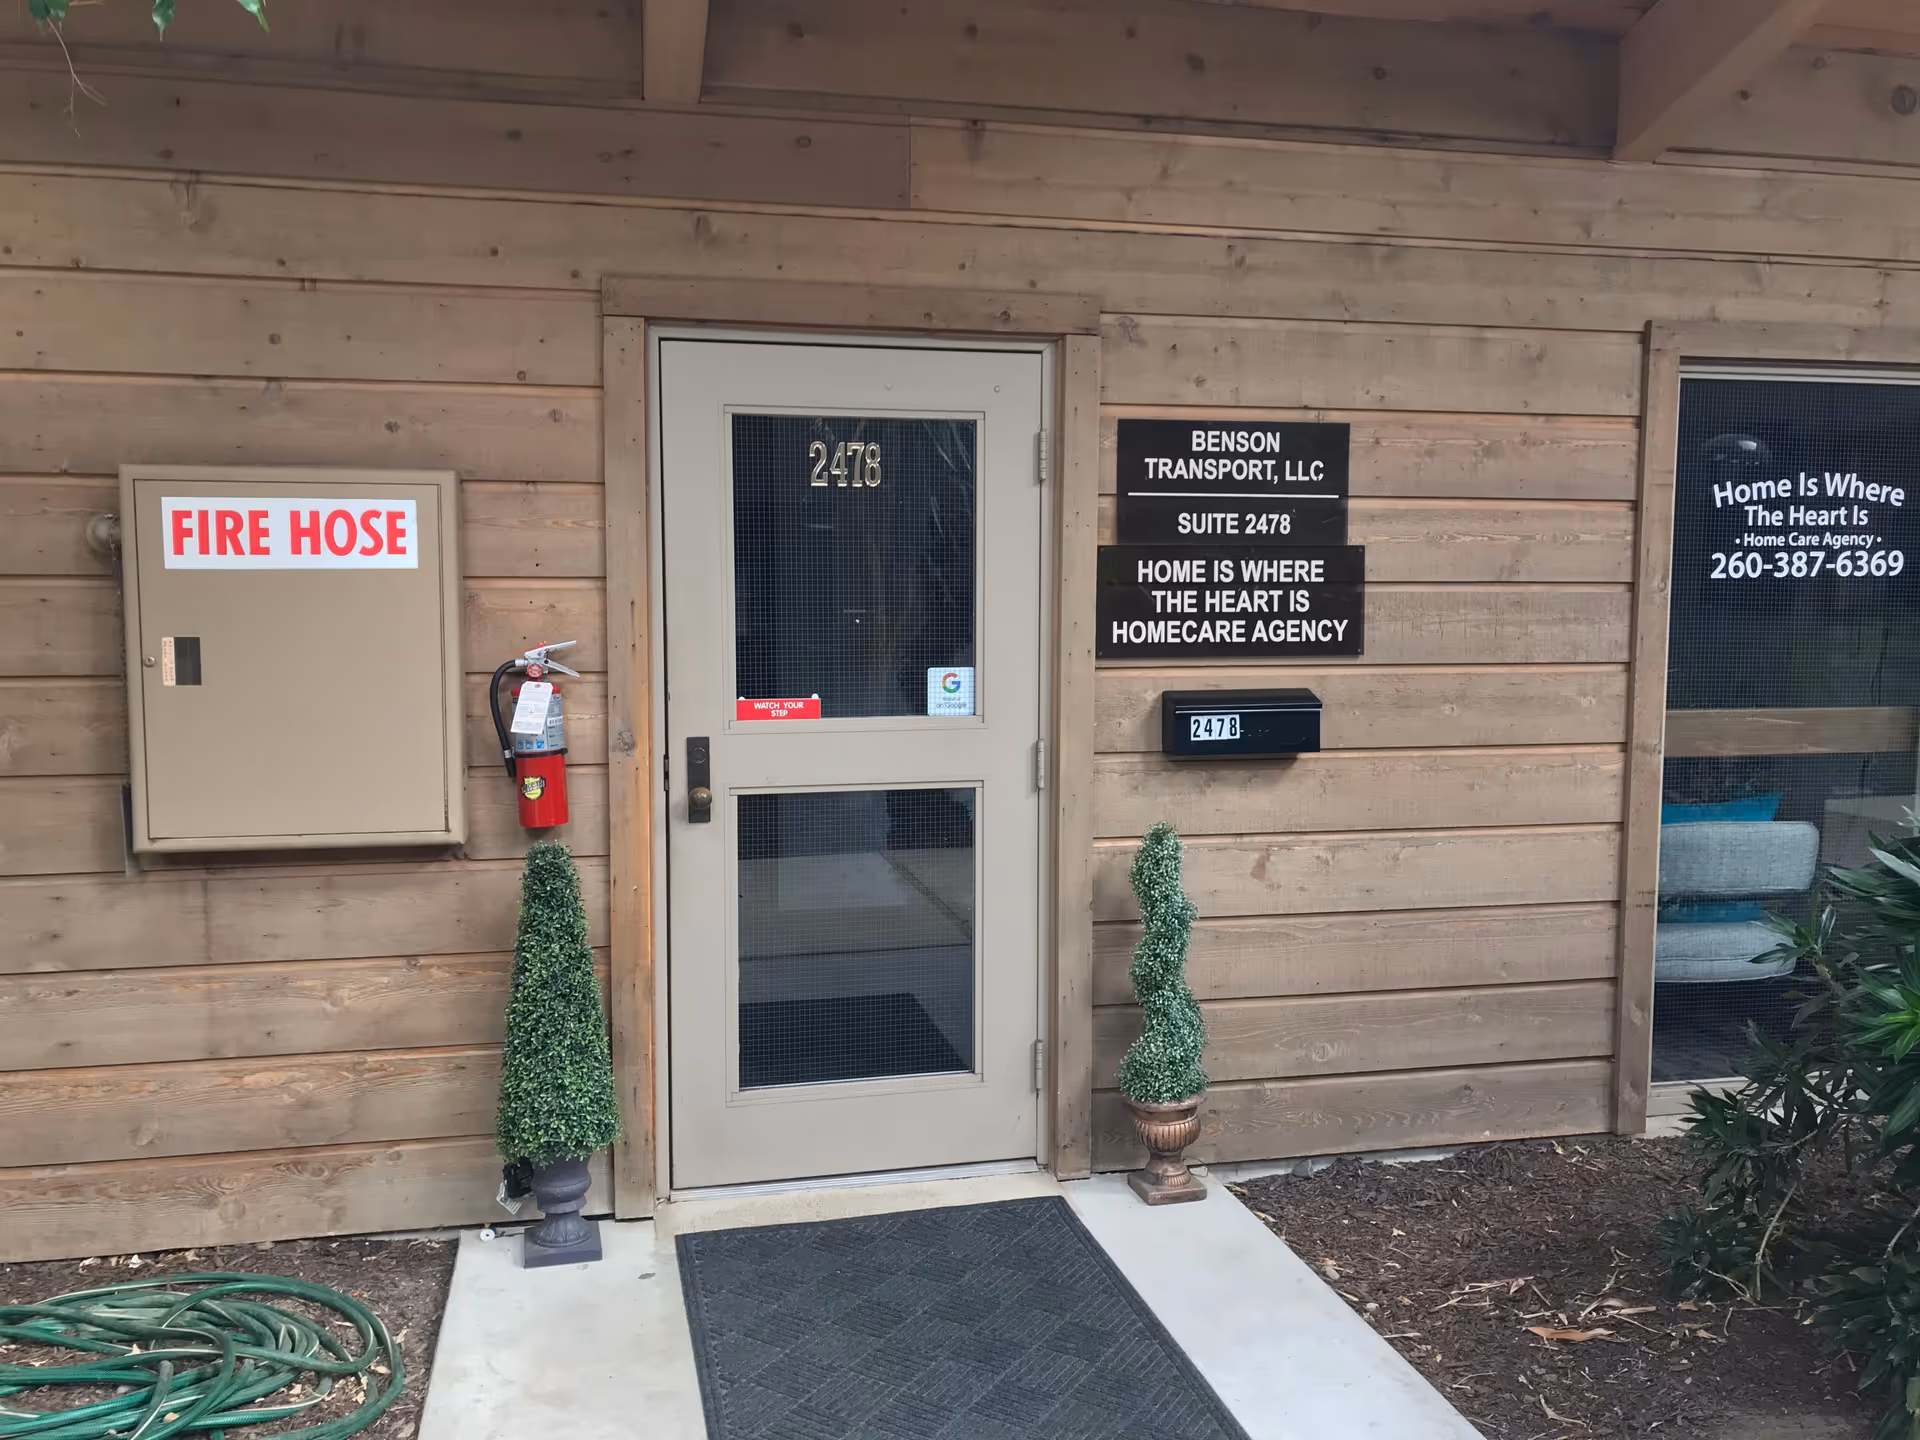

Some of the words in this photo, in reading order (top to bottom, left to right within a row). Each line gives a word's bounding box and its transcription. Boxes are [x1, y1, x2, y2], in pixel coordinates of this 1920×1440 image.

[1191, 430, 1280, 453] BENSON
[809, 441, 882, 487] 2478
[1144, 457, 1279, 485] TRANSPORT,
[1285, 460, 1325, 481] LLC
[1713, 477, 1792, 508] Home
[1799, 471, 1818, 497] Is
[1824, 472, 1905, 507] Where
[1177, 512, 1239, 535] SUITE
[1245, 513, 1291, 535] 2478
[1744, 504, 1783, 526] The
[1789, 505, 1847, 526] Heart
[1852, 505, 1868, 525] Is
[171, 509, 270, 556] FIRE
[289, 509, 407, 557] HOSE
[1744, 532, 1785, 547] Home
[1788, 532, 1819, 546] Care
[1823, 532, 1874, 549] Agency
[1137, 560, 1206, 583] HOME
[1213, 560, 1234, 583] IS
[1240, 560, 1325, 583] WHERE
[1710, 550, 1904, 579] 260-387-6369
[1151, 590, 1197, 613] THE
[1205, 590, 1283, 613] HEART
[1289, 590, 1310, 612] IS
[1112, 620, 1246, 644] HOMECARE
[1251, 619, 1349, 642] AGENCY
[771, 709, 788, 717] STEP
[1192, 717, 1238, 738] 2478
